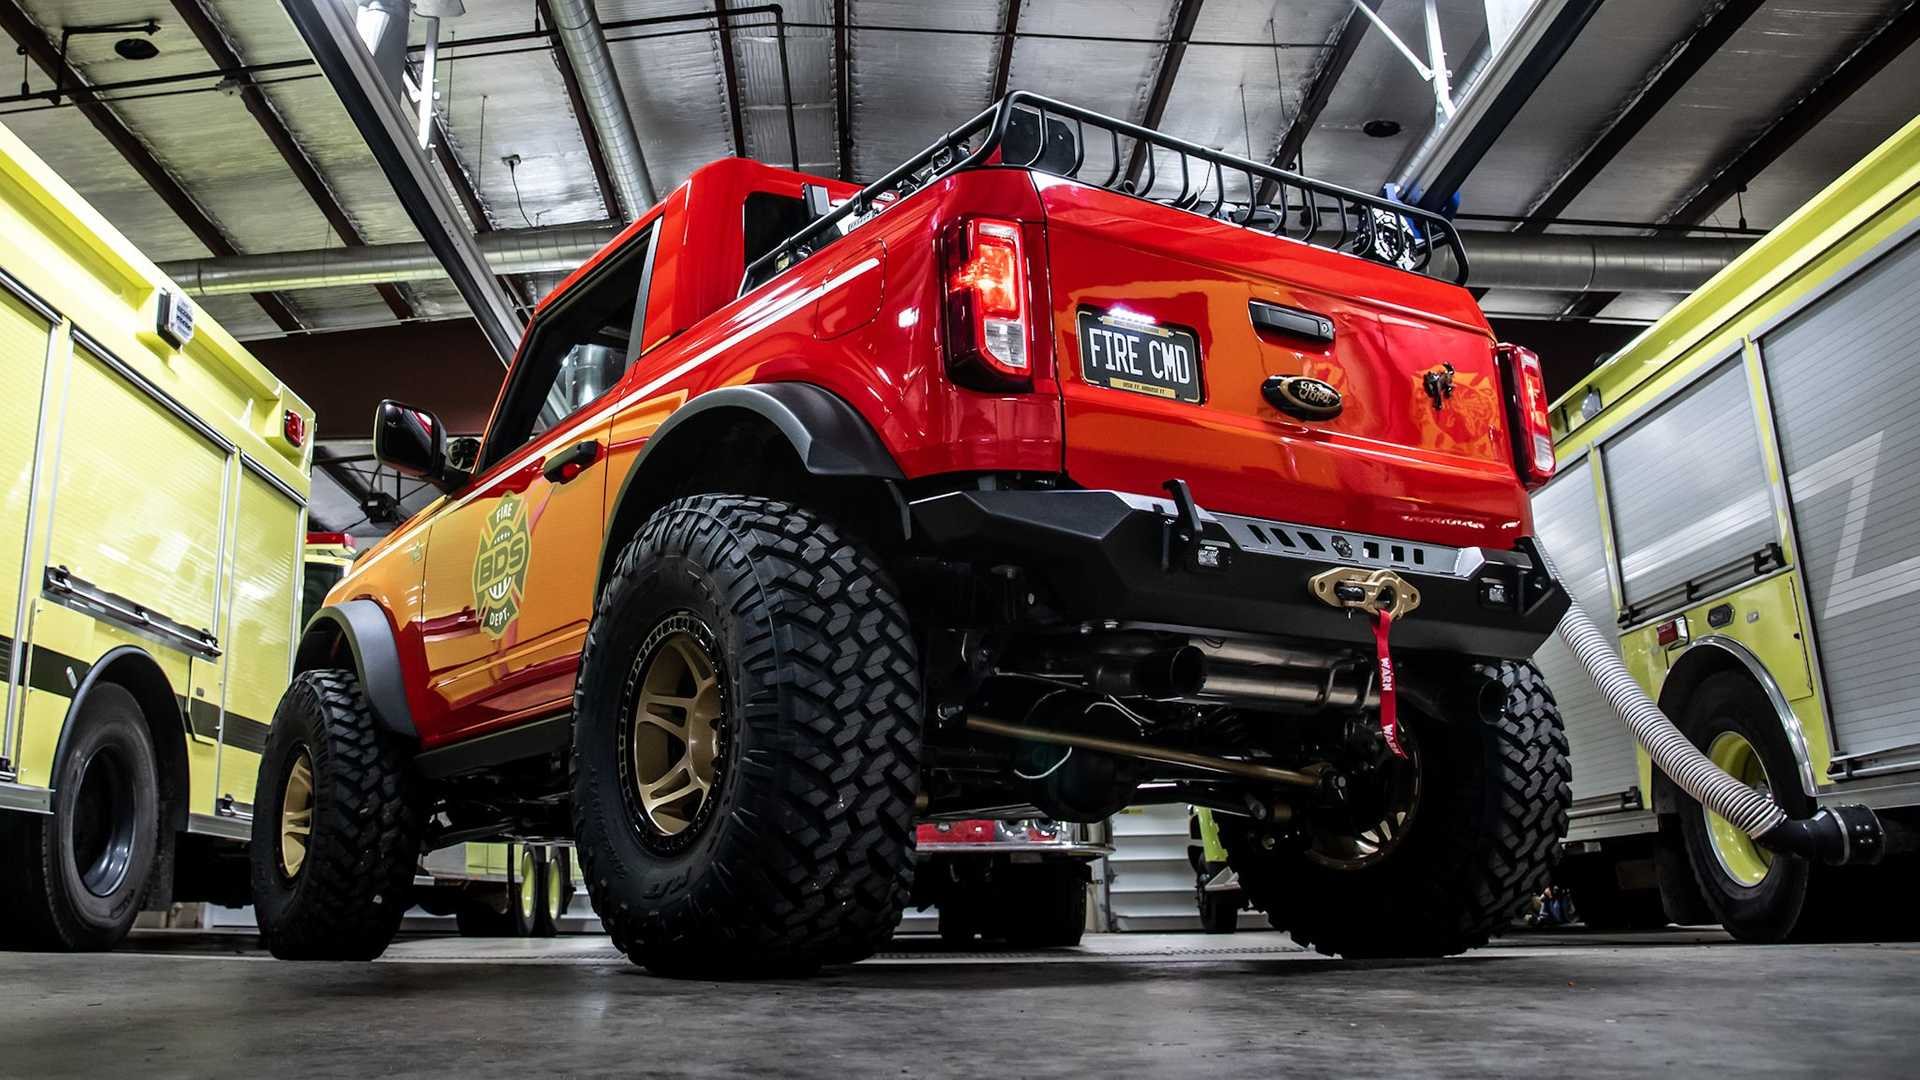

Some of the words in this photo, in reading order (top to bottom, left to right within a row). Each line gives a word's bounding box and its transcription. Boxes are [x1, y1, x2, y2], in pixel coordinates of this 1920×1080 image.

[1088, 327, 1143, 376] FIRE
[1148, 339, 1191, 384] CMD
[1298, 380, 1332, 404] Ford
[496, 502, 513, 523] FIRE
[479, 533, 526, 590] BDS
[489, 606, 510, 627] DEPT.
[1380, 657, 1393, 691] WARN
